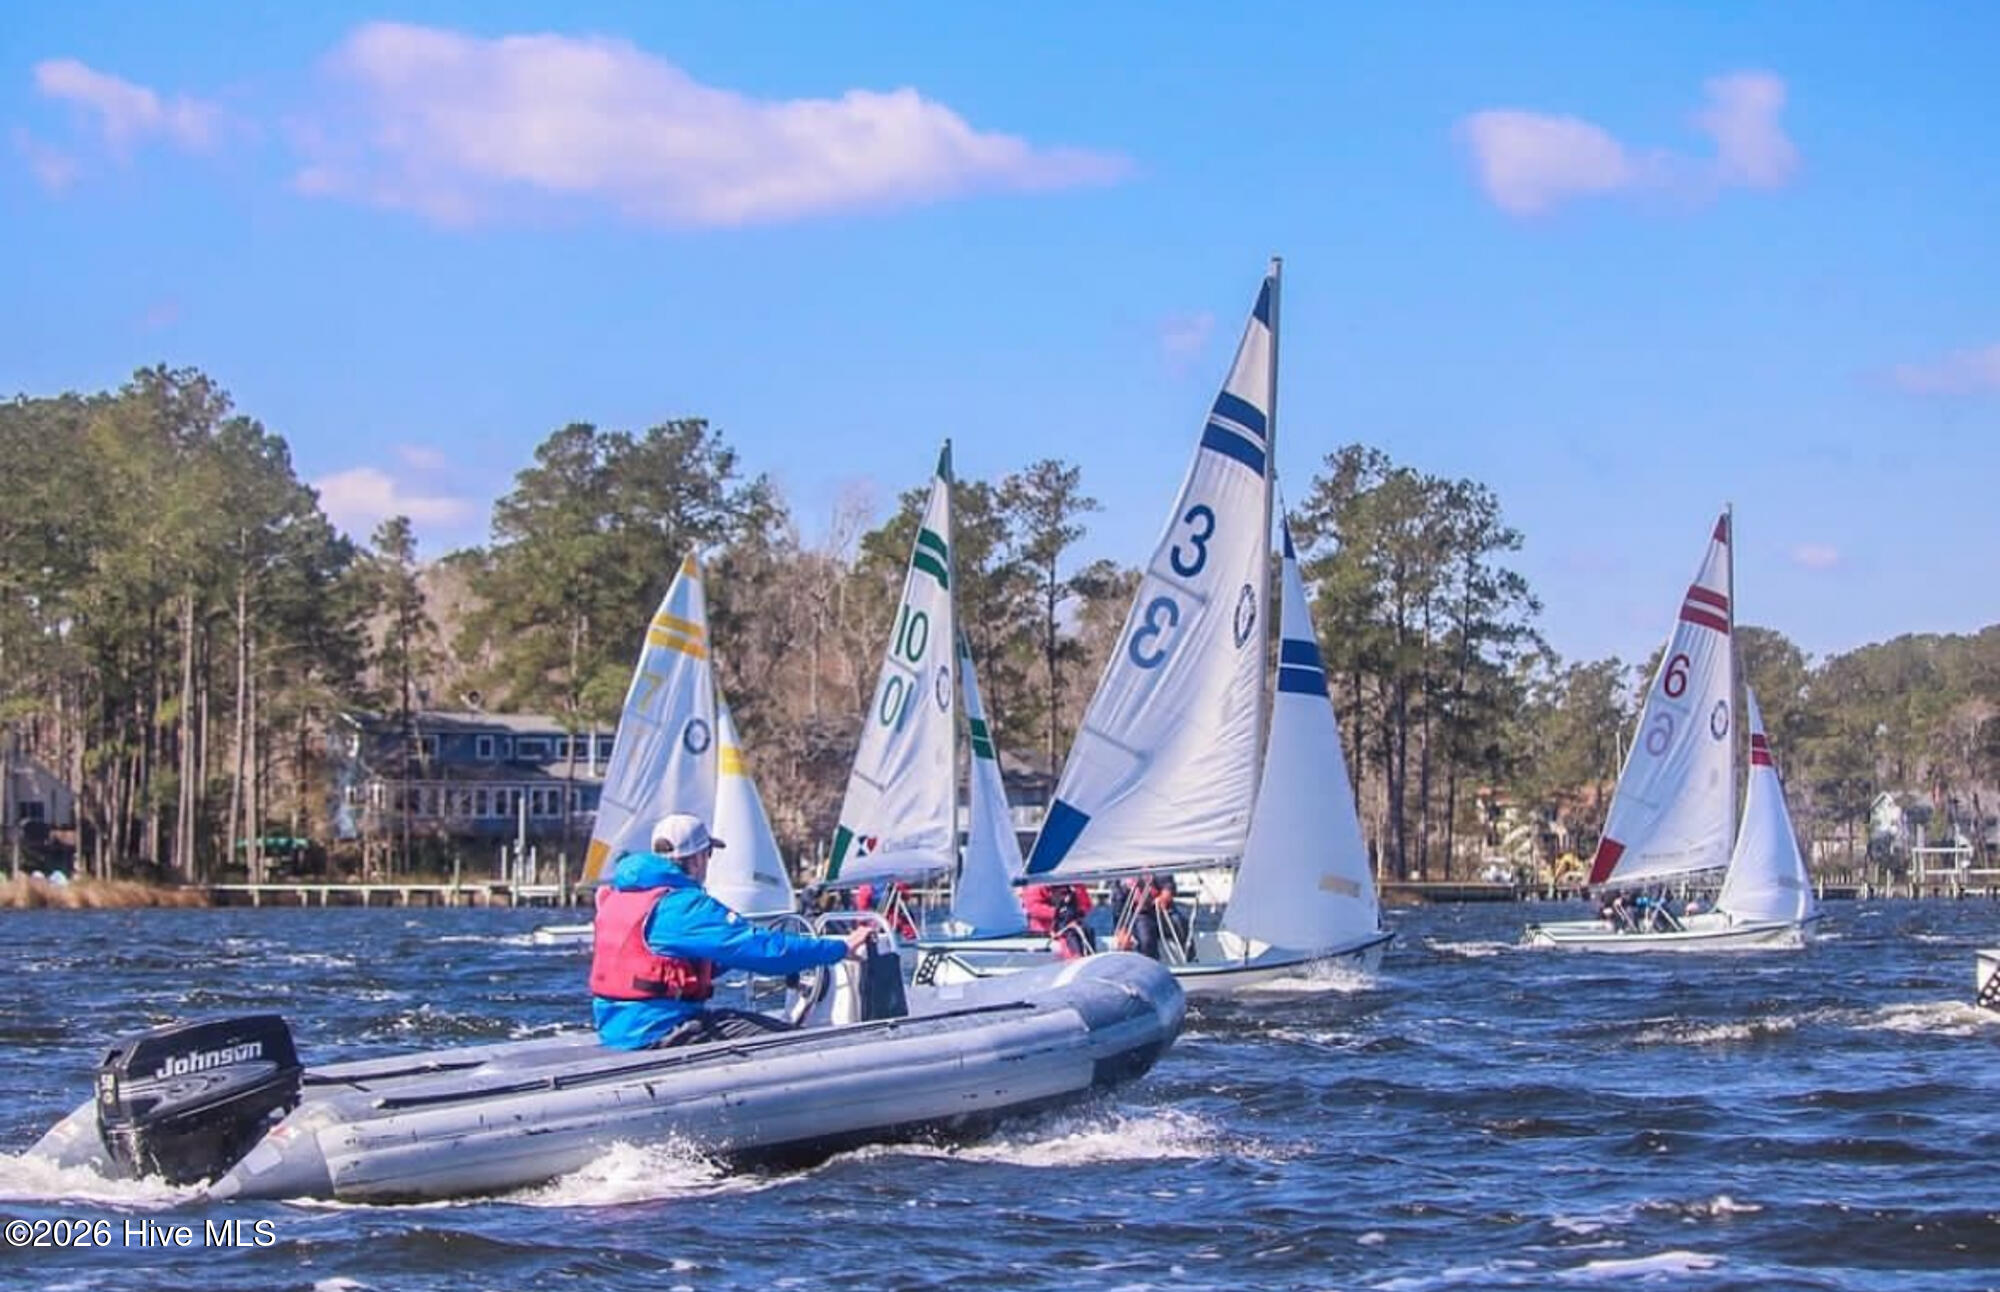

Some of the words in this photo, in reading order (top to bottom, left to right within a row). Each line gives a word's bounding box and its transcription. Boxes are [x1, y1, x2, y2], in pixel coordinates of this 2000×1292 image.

[1170, 503, 1215, 578] 3
[895, 603, 929, 663] 10
[1664, 653, 1690, 698] 6
[156, 1041, 262, 1080] Johnson
